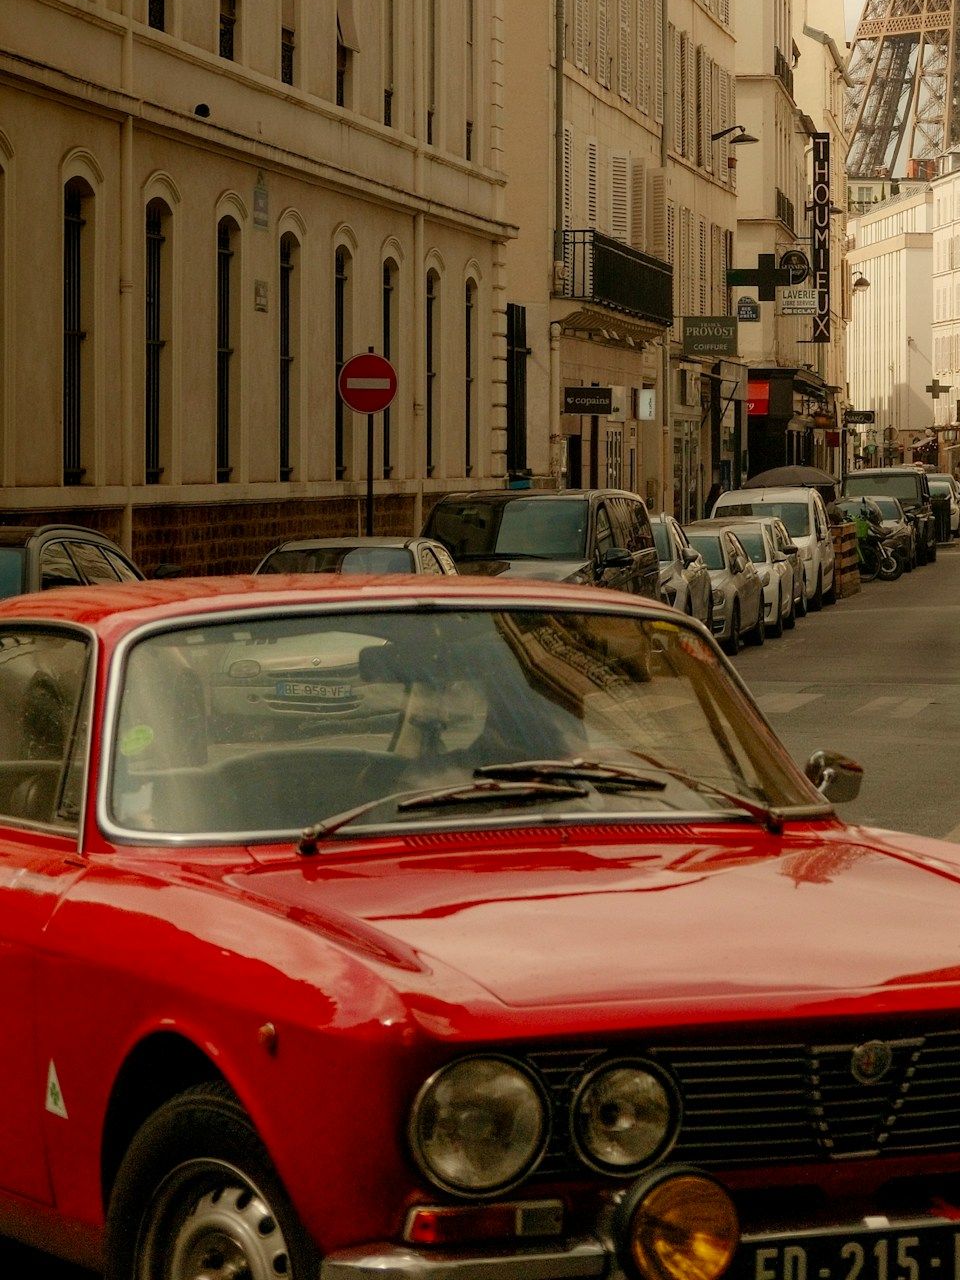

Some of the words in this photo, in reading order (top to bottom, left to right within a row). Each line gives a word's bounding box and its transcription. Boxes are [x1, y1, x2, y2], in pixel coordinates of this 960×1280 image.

[814, 138, 829, 338] THOUMIEUX
[782, 290, 816, 299] LAVERIE
[686, 326, 735, 336] PROVOST
[693, 343, 728, 351] COIFFURE
[575, 396, 609, 406] copains
